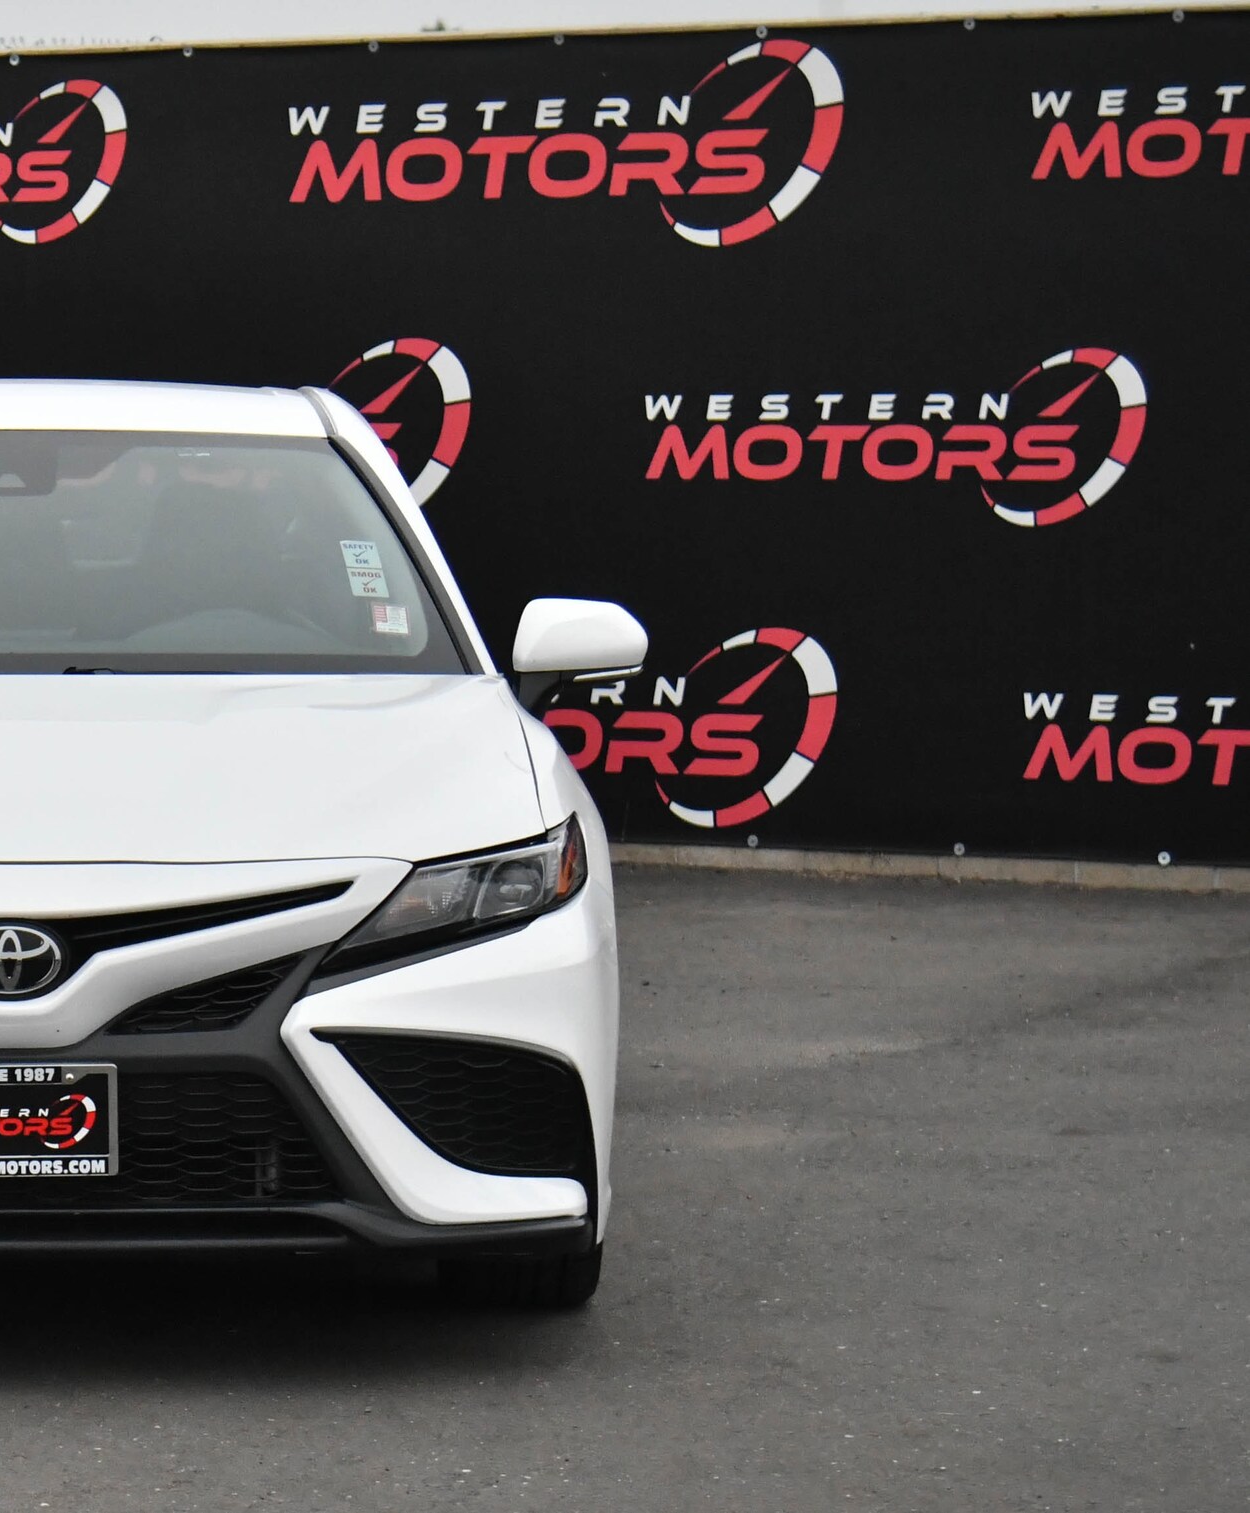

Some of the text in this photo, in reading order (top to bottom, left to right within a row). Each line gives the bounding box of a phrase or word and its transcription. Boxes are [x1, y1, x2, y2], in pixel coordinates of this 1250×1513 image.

[288, 95, 691, 136] WESTERN
[1031, 85, 1246, 118] WEST
[289, 128, 769, 203] MOTORS
[644, 393, 1009, 421] WESTERN
[645, 425, 1080, 482] MOTORS
[343, 543, 374, 551] SAFETY
[350, 571, 382, 579] SMOG
[1023, 692, 1237, 725] WEST
[14, 1067, 55, 1082] 1987
